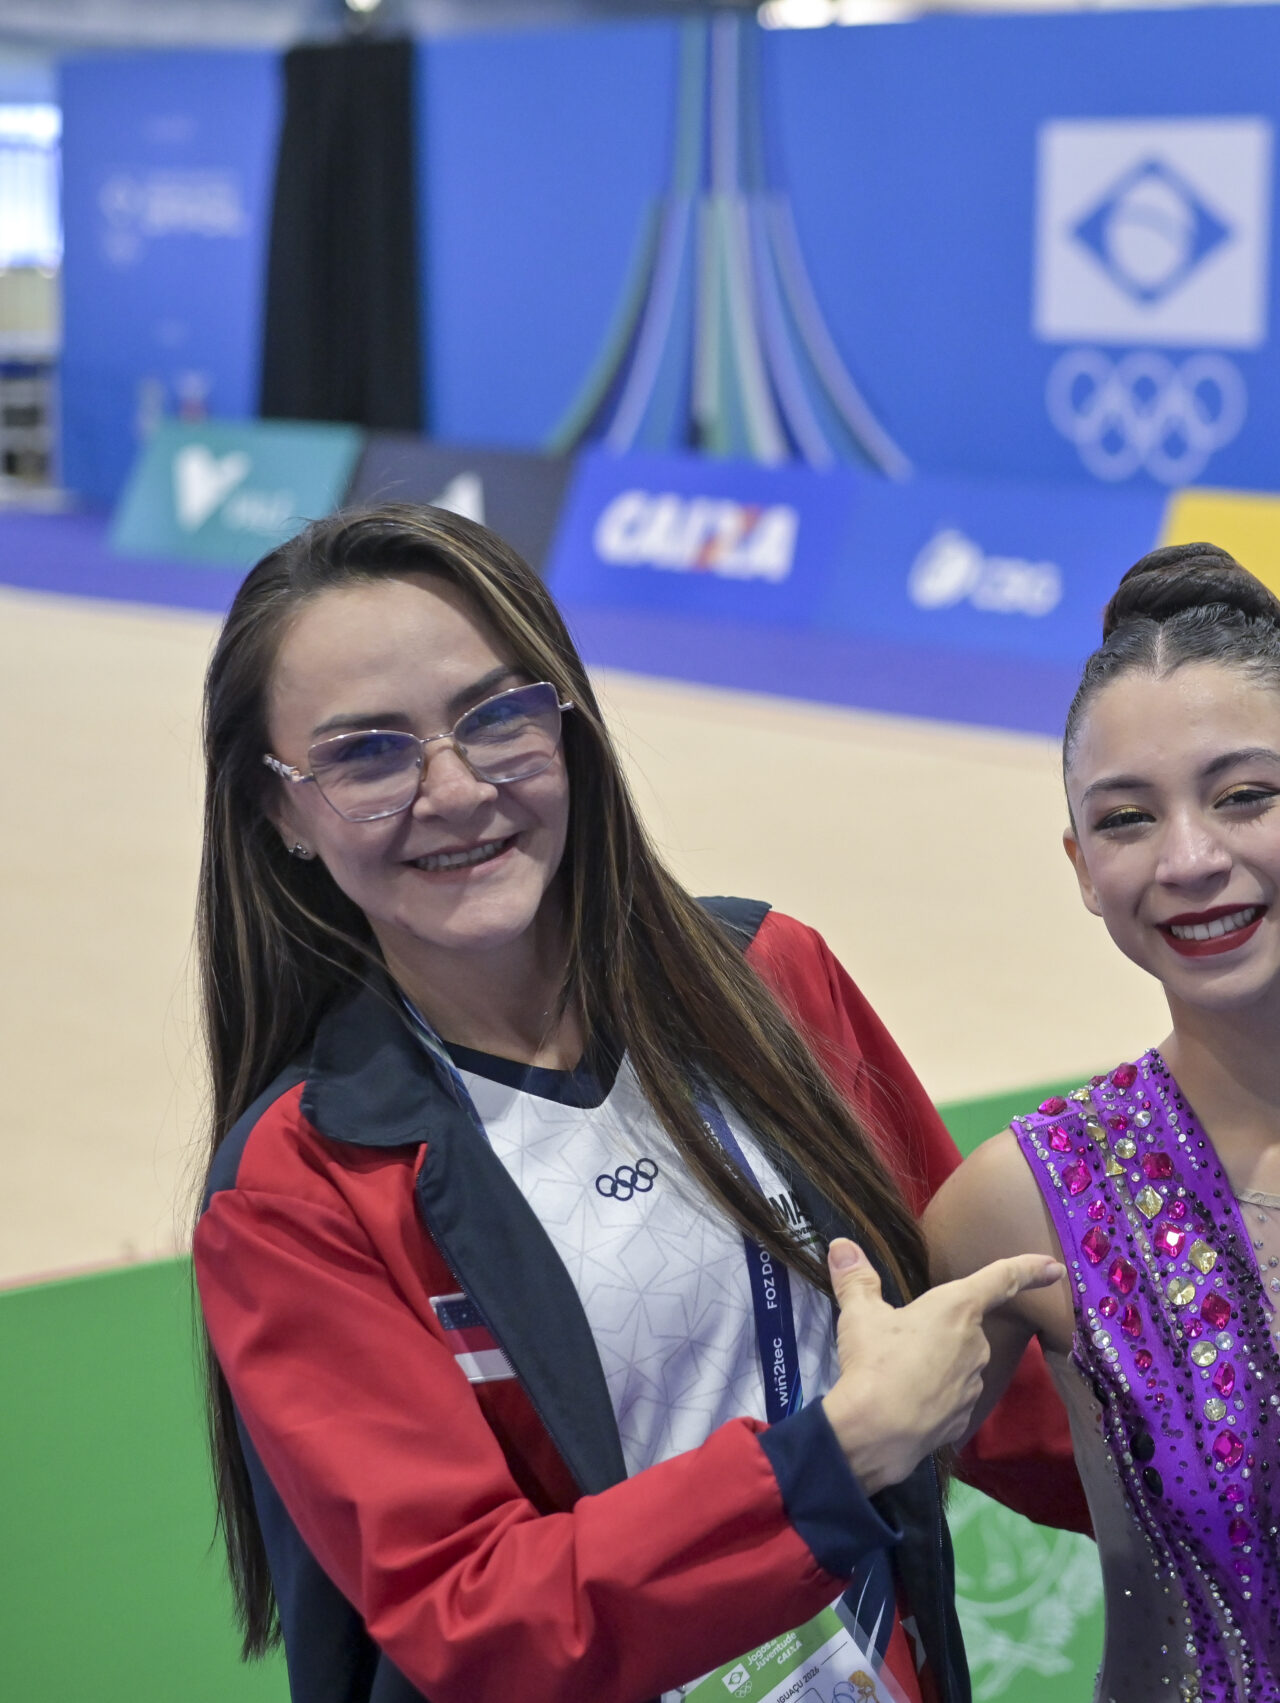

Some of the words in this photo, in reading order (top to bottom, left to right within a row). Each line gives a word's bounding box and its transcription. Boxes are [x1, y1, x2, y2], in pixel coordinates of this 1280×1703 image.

[596, 490, 797, 582] CAIXA
[759, 1250, 773, 1276] DO
[763, 1276, 778, 1310] FOZ
[773, 1337, 788, 1407] win2tec
[748, 1642, 771, 1666] Jogos
[755, 1632, 797, 1671] Juventude
[777, 1640, 802, 1665] CAIXA
[802, 1666, 820, 1684] 2026
